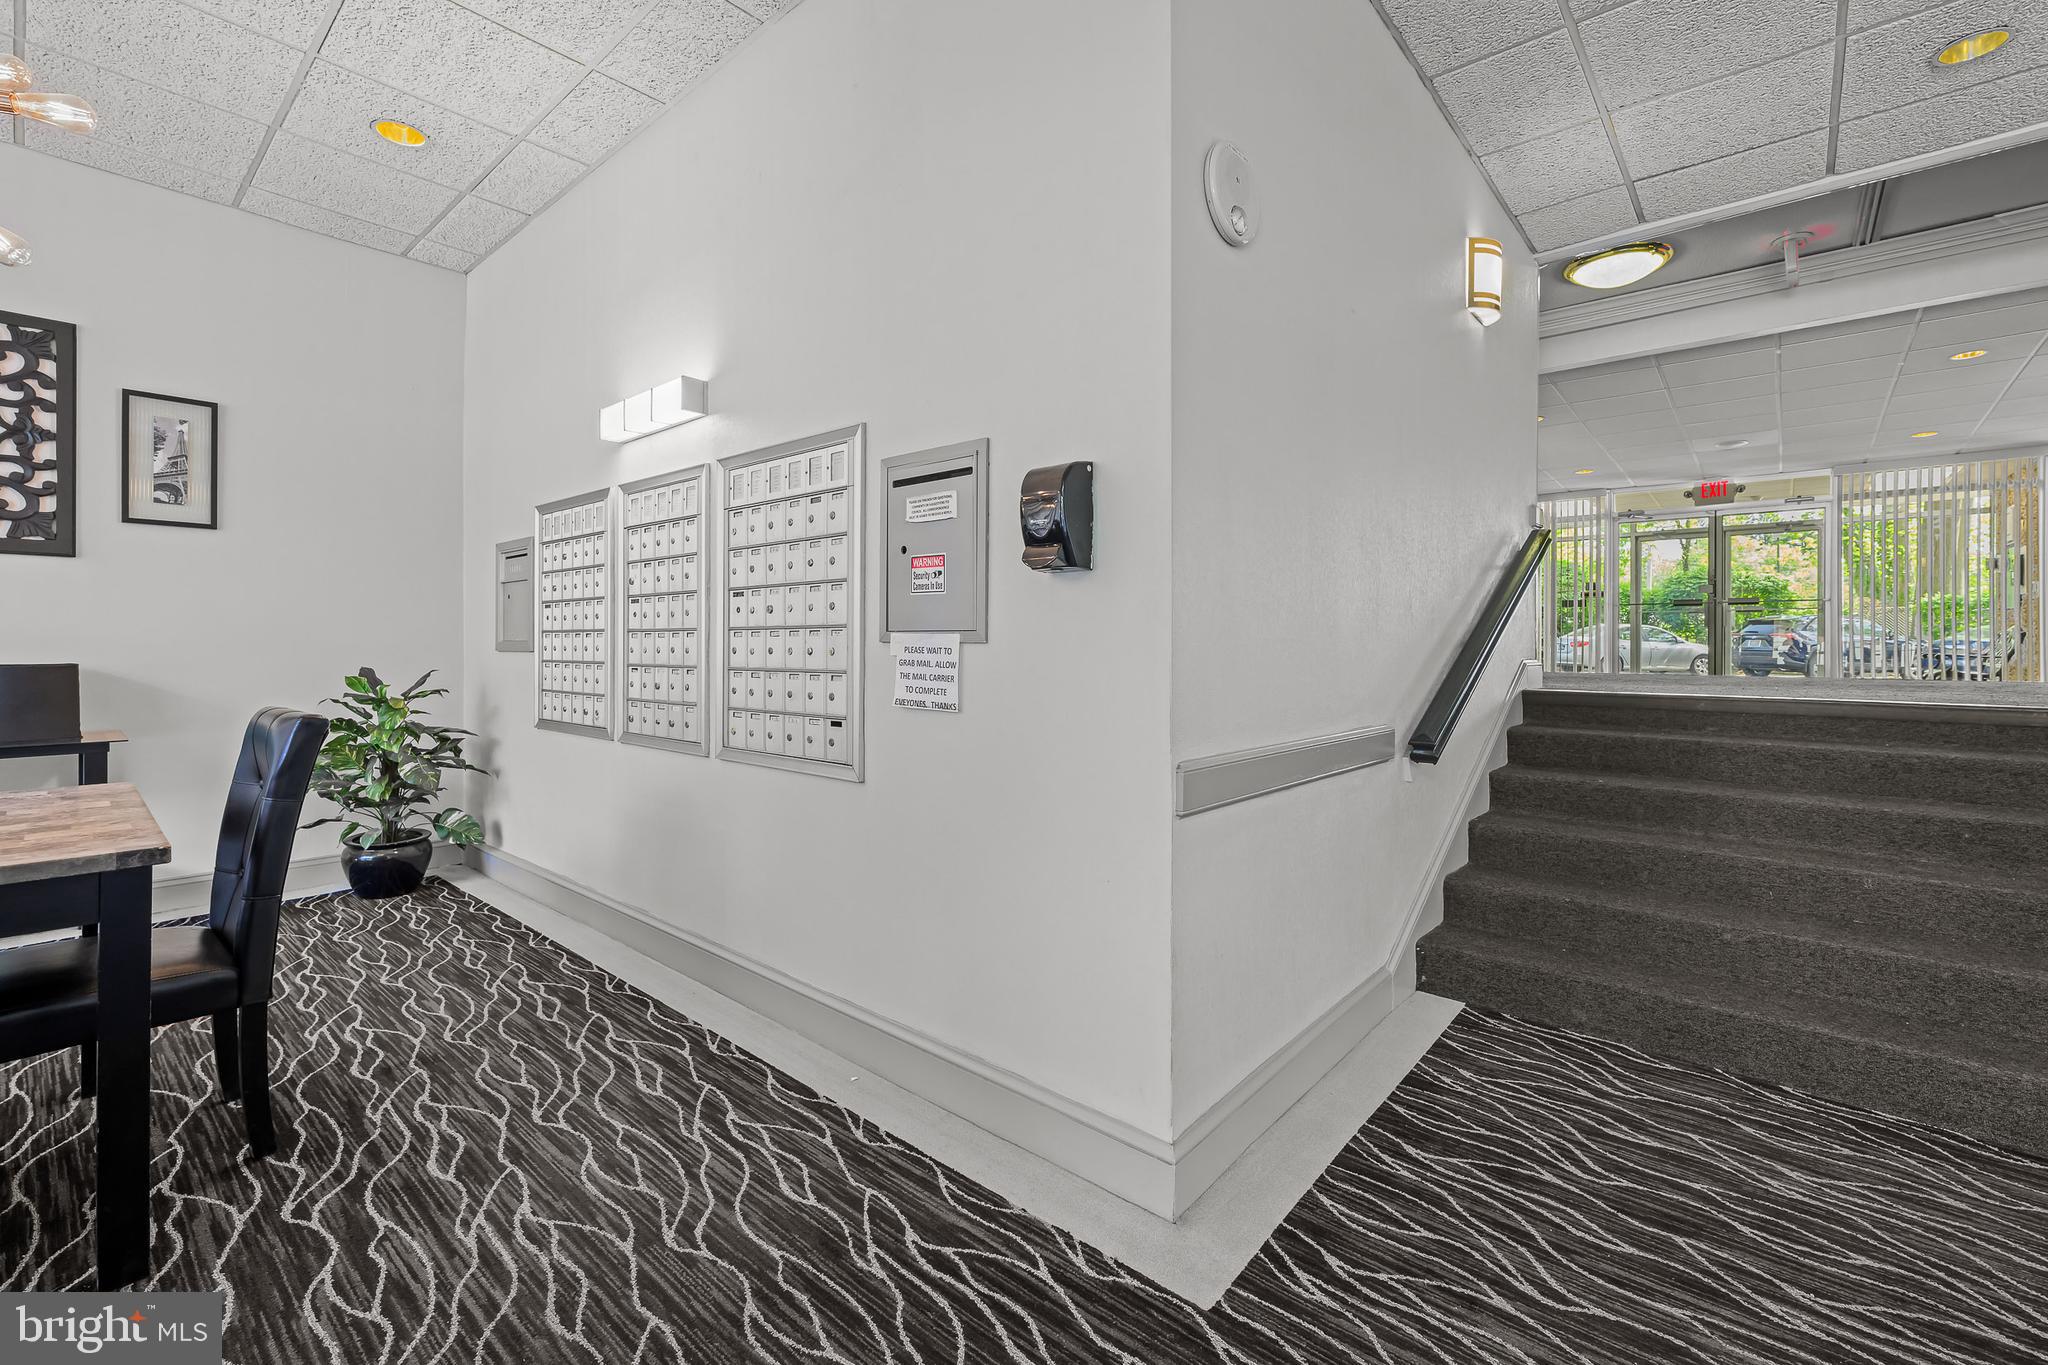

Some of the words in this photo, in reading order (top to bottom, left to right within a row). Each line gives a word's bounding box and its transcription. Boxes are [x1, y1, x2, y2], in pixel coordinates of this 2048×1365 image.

[1702, 480, 1728, 498] EXIT
[912, 556, 944, 567] WARNING
[913, 571, 930, 581] Security
[913, 582, 930, 591] Cameras
[935, 581, 943, 590] Use
[904, 646, 925, 654] PLEASE
[926, 647, 943, 655] WAIT
[944, 647, 952, 655] TO
[898, 659, 915, 667] GRAB
[935, 661, 957, 669] ALLOW
[899, 672, 911, 680] THE
[912, 673, 928, 681] MAIL
[928, 673, 955, 683] CARRIER
[905, 685, 914, 694] TO
[914, 686, 947, 696] COMPLETE
[931, 701, 957, 711] THANKS
